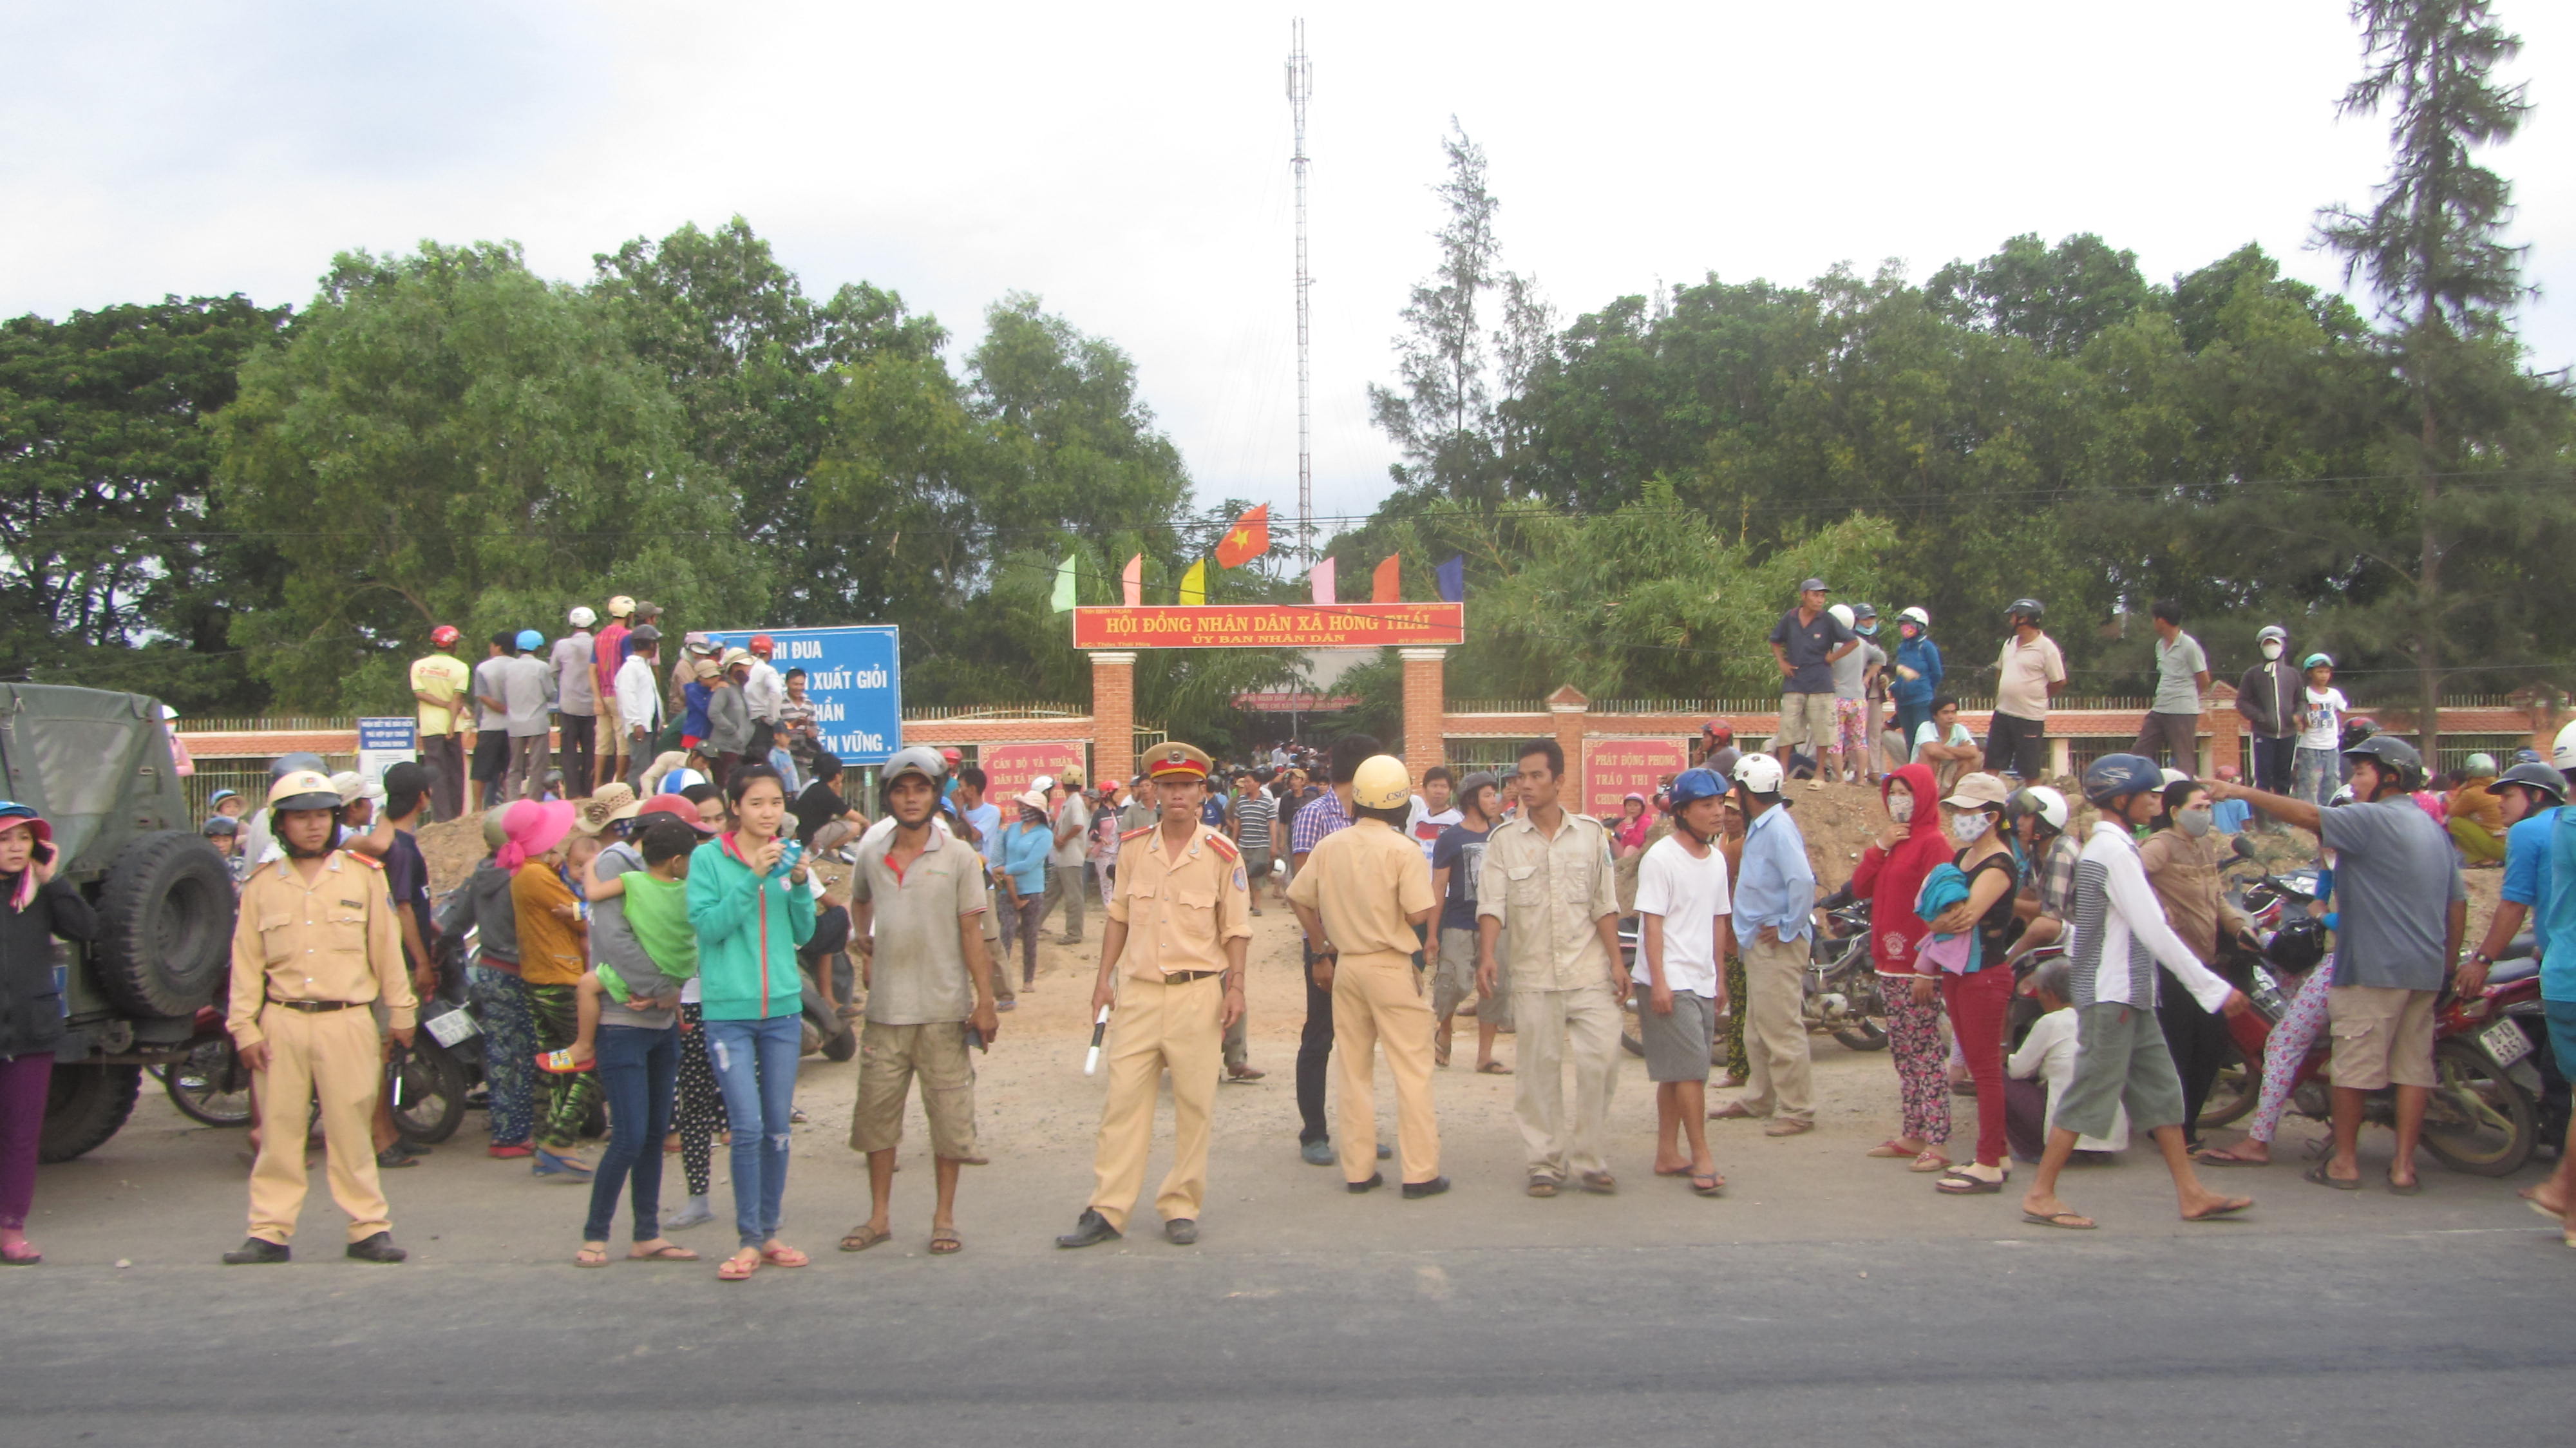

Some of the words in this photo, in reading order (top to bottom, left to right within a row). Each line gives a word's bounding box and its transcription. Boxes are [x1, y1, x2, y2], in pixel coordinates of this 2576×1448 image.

[1106, 614, 1137, 636] HỘI
[1142, 611, 1192, 633] ĐỒNG
[1197, 614, 1248, 632] NHÂN
[1254, 613, 1291, 631] DÂN
[1297, 613, 1323, 631] XÃ
[1329, 608, 1379, 631] HỒNG
[1385, 611, 1430, 629] THÁI
[1192, 634, 1214, 643] ỦY
[1258, 633, 1305, 643] NHÂN
[1310, 634, 1345, 643] DÂN
[773, 642, 787, 660] HI
[791, 641, 822, 659] ĐUA
[813, 665, 852, 690] XUẤT
[857, 664, 887, 689] GIỎI
[814, 696, 844, 721] HẦN
[993, 757, 1010, 768] CÁN
[1016, 757, 1027, 770] BỘ
[1595, 752, 1618, 766] PHÁT
[1621, 752, 1644, 768] ĐỘNG
[1648, 755, 1676, 766] PHONG
[1631, 775, 1648, 785] THI
